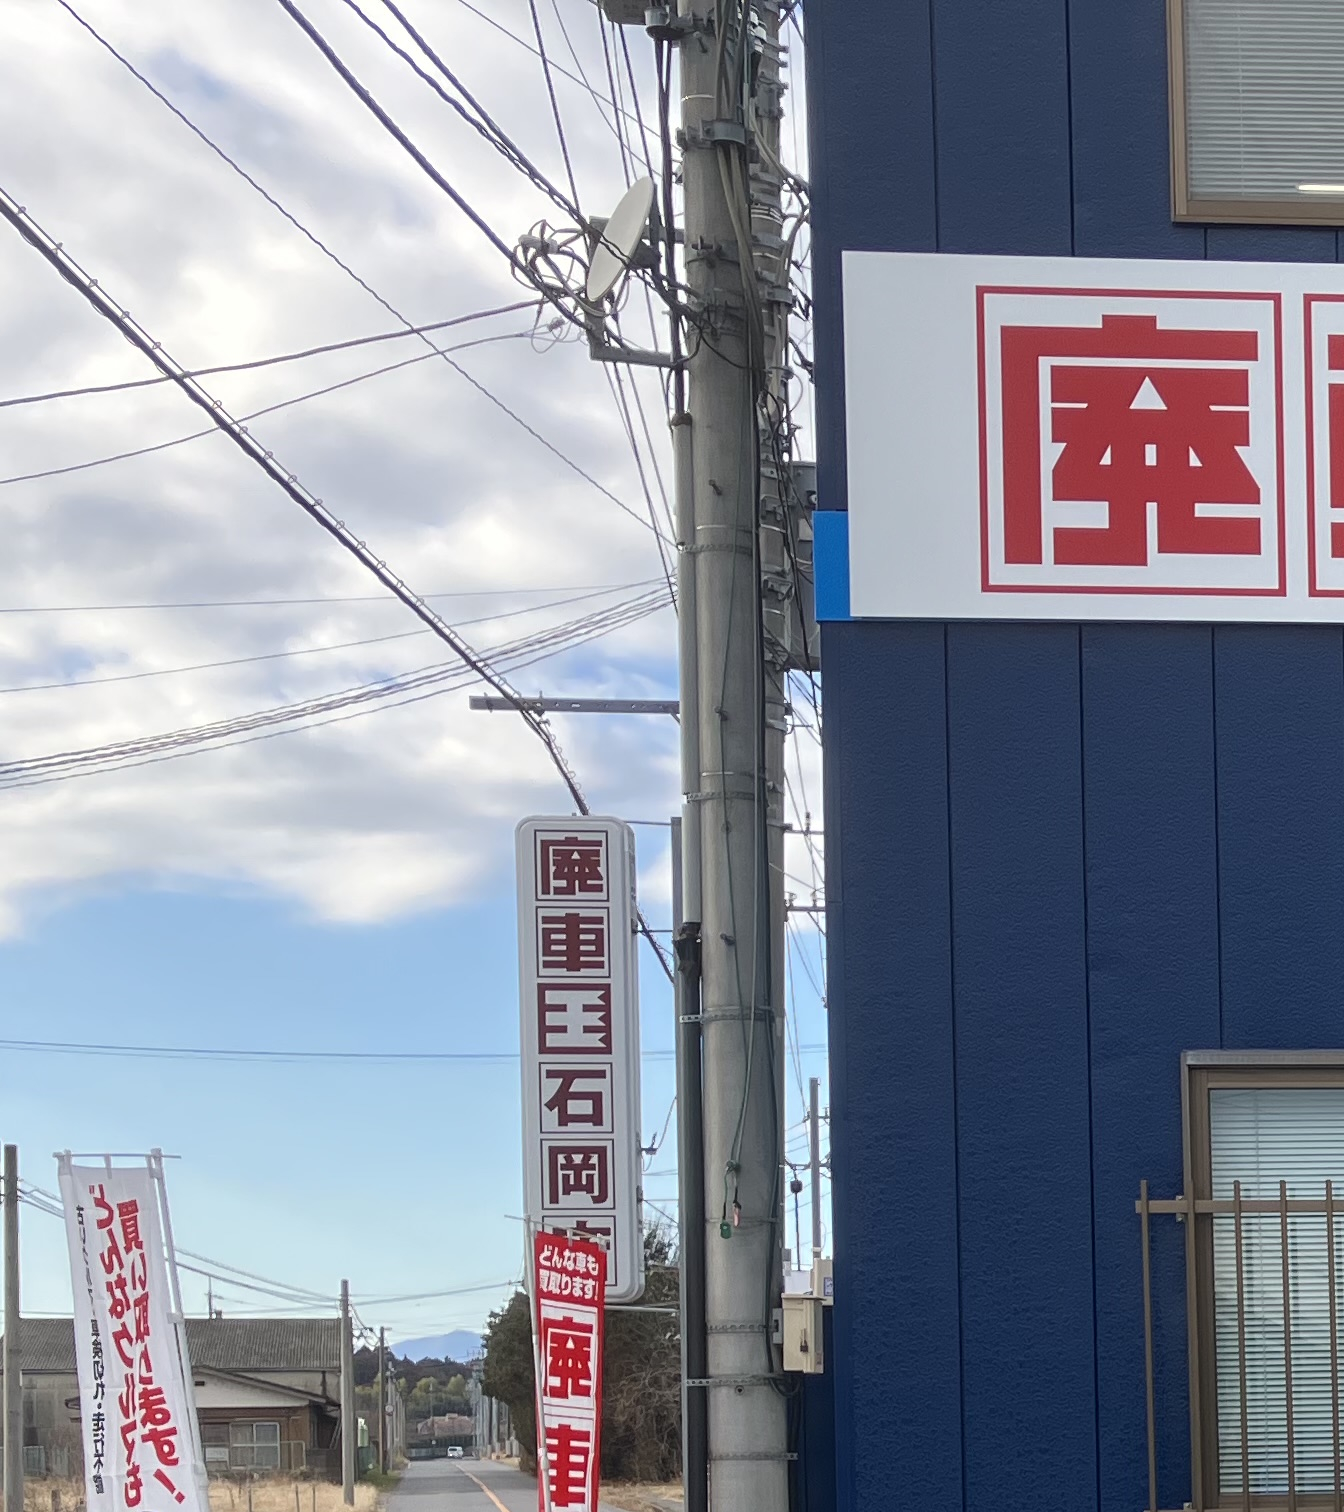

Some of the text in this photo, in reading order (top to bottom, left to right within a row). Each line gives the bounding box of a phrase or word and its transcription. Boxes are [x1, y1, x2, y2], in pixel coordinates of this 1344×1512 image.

[537, 836, 613, 1248] 廃車王石岡
[538, 1244, 599, 1276] どんな車も
[538, 1268, 599, 1301] 買取ります!
